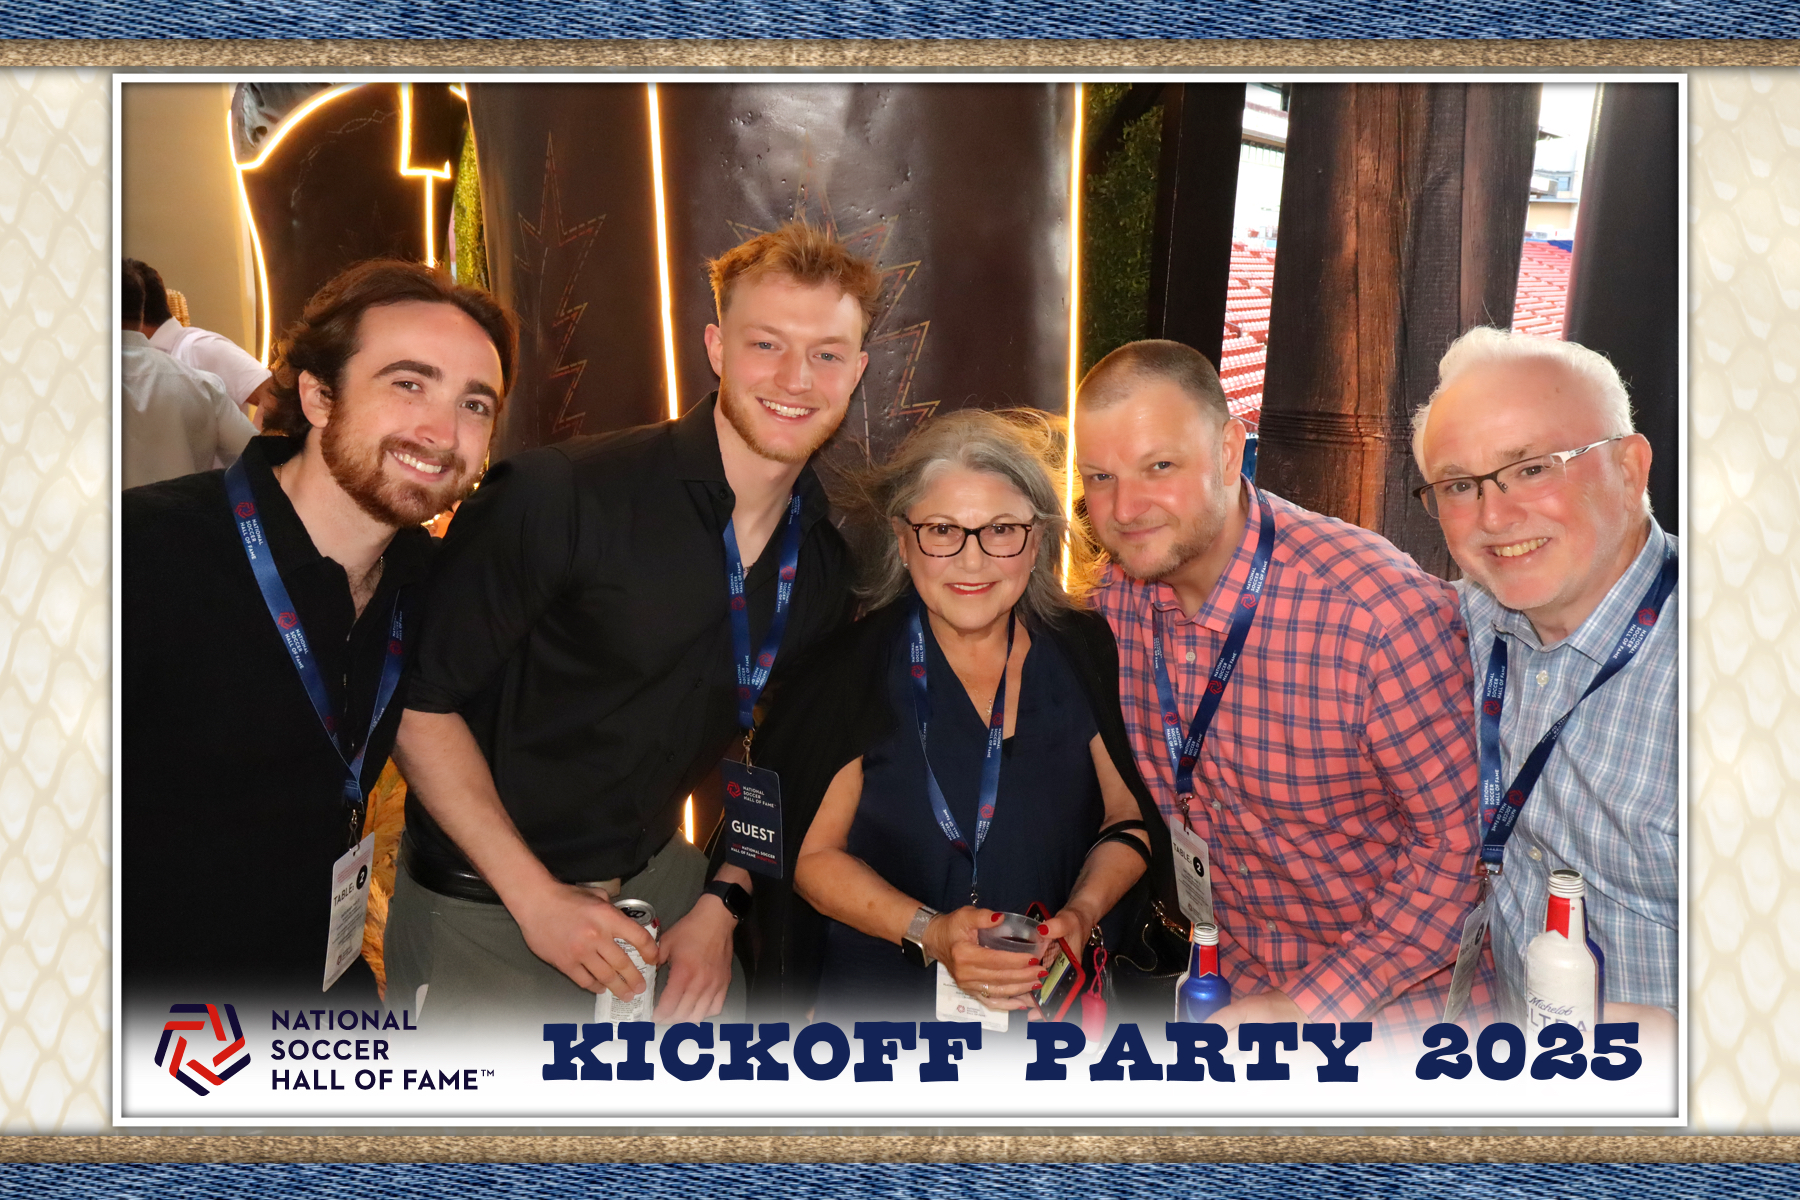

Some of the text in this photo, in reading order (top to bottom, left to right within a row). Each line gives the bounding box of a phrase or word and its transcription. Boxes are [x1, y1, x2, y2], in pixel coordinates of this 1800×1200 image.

[240, 522, 257, 560] HALL OF FAME
[246, 520, 257, 542] SOCCER
[252, 519, 264, 545] NATIONAL
[1246, 567, 1257, 591] NATIONAL
[1251, 572, 1259, 591] SOCCER
[1255, 581, 1263, 593] HALL
[1259, 573, 1264, 581] OF
[290, 631, 303, 652] SOCCER
[295, 629, 309, 654] NATIONAL
[1612, 623, 1636, 660] HALL OF FAME
[1626, 627, 1642, 648] SOCCER
[1628, 629, 1647, 655] NATIONAL
[285, 633, 304, 669] HALL OF FAME
[1213, 657, 1225, 677] NATIONAL
[1218, 662, 1227, 679] SOCCER
[1222, 670, 1230, 681] HALL
[1229, 652, 1237, 664] FAME
[1486, 672, 1495, 698] NATIONAL
[1175, 727, 1183, 749] NATIONAL
[742, 786, 765, 796] NATIONAL
[743, 791, 761, 799] SOCCER
[1495, 783, 1500, 791] OF
[1502, 805, 1512, 823] SOCCER
[1505, 809, 1517, 827] NATIONAL
[731, 820, 775, 843] GUEST
[1491, 821, 1499, 832] FAME
[359, 871, 365, 883] 2
[1196, 862, 1201, 873] 2
[1529, 992, 1575, 1016] Michelob
[1526, 1005, 1587, 1032] LTA
